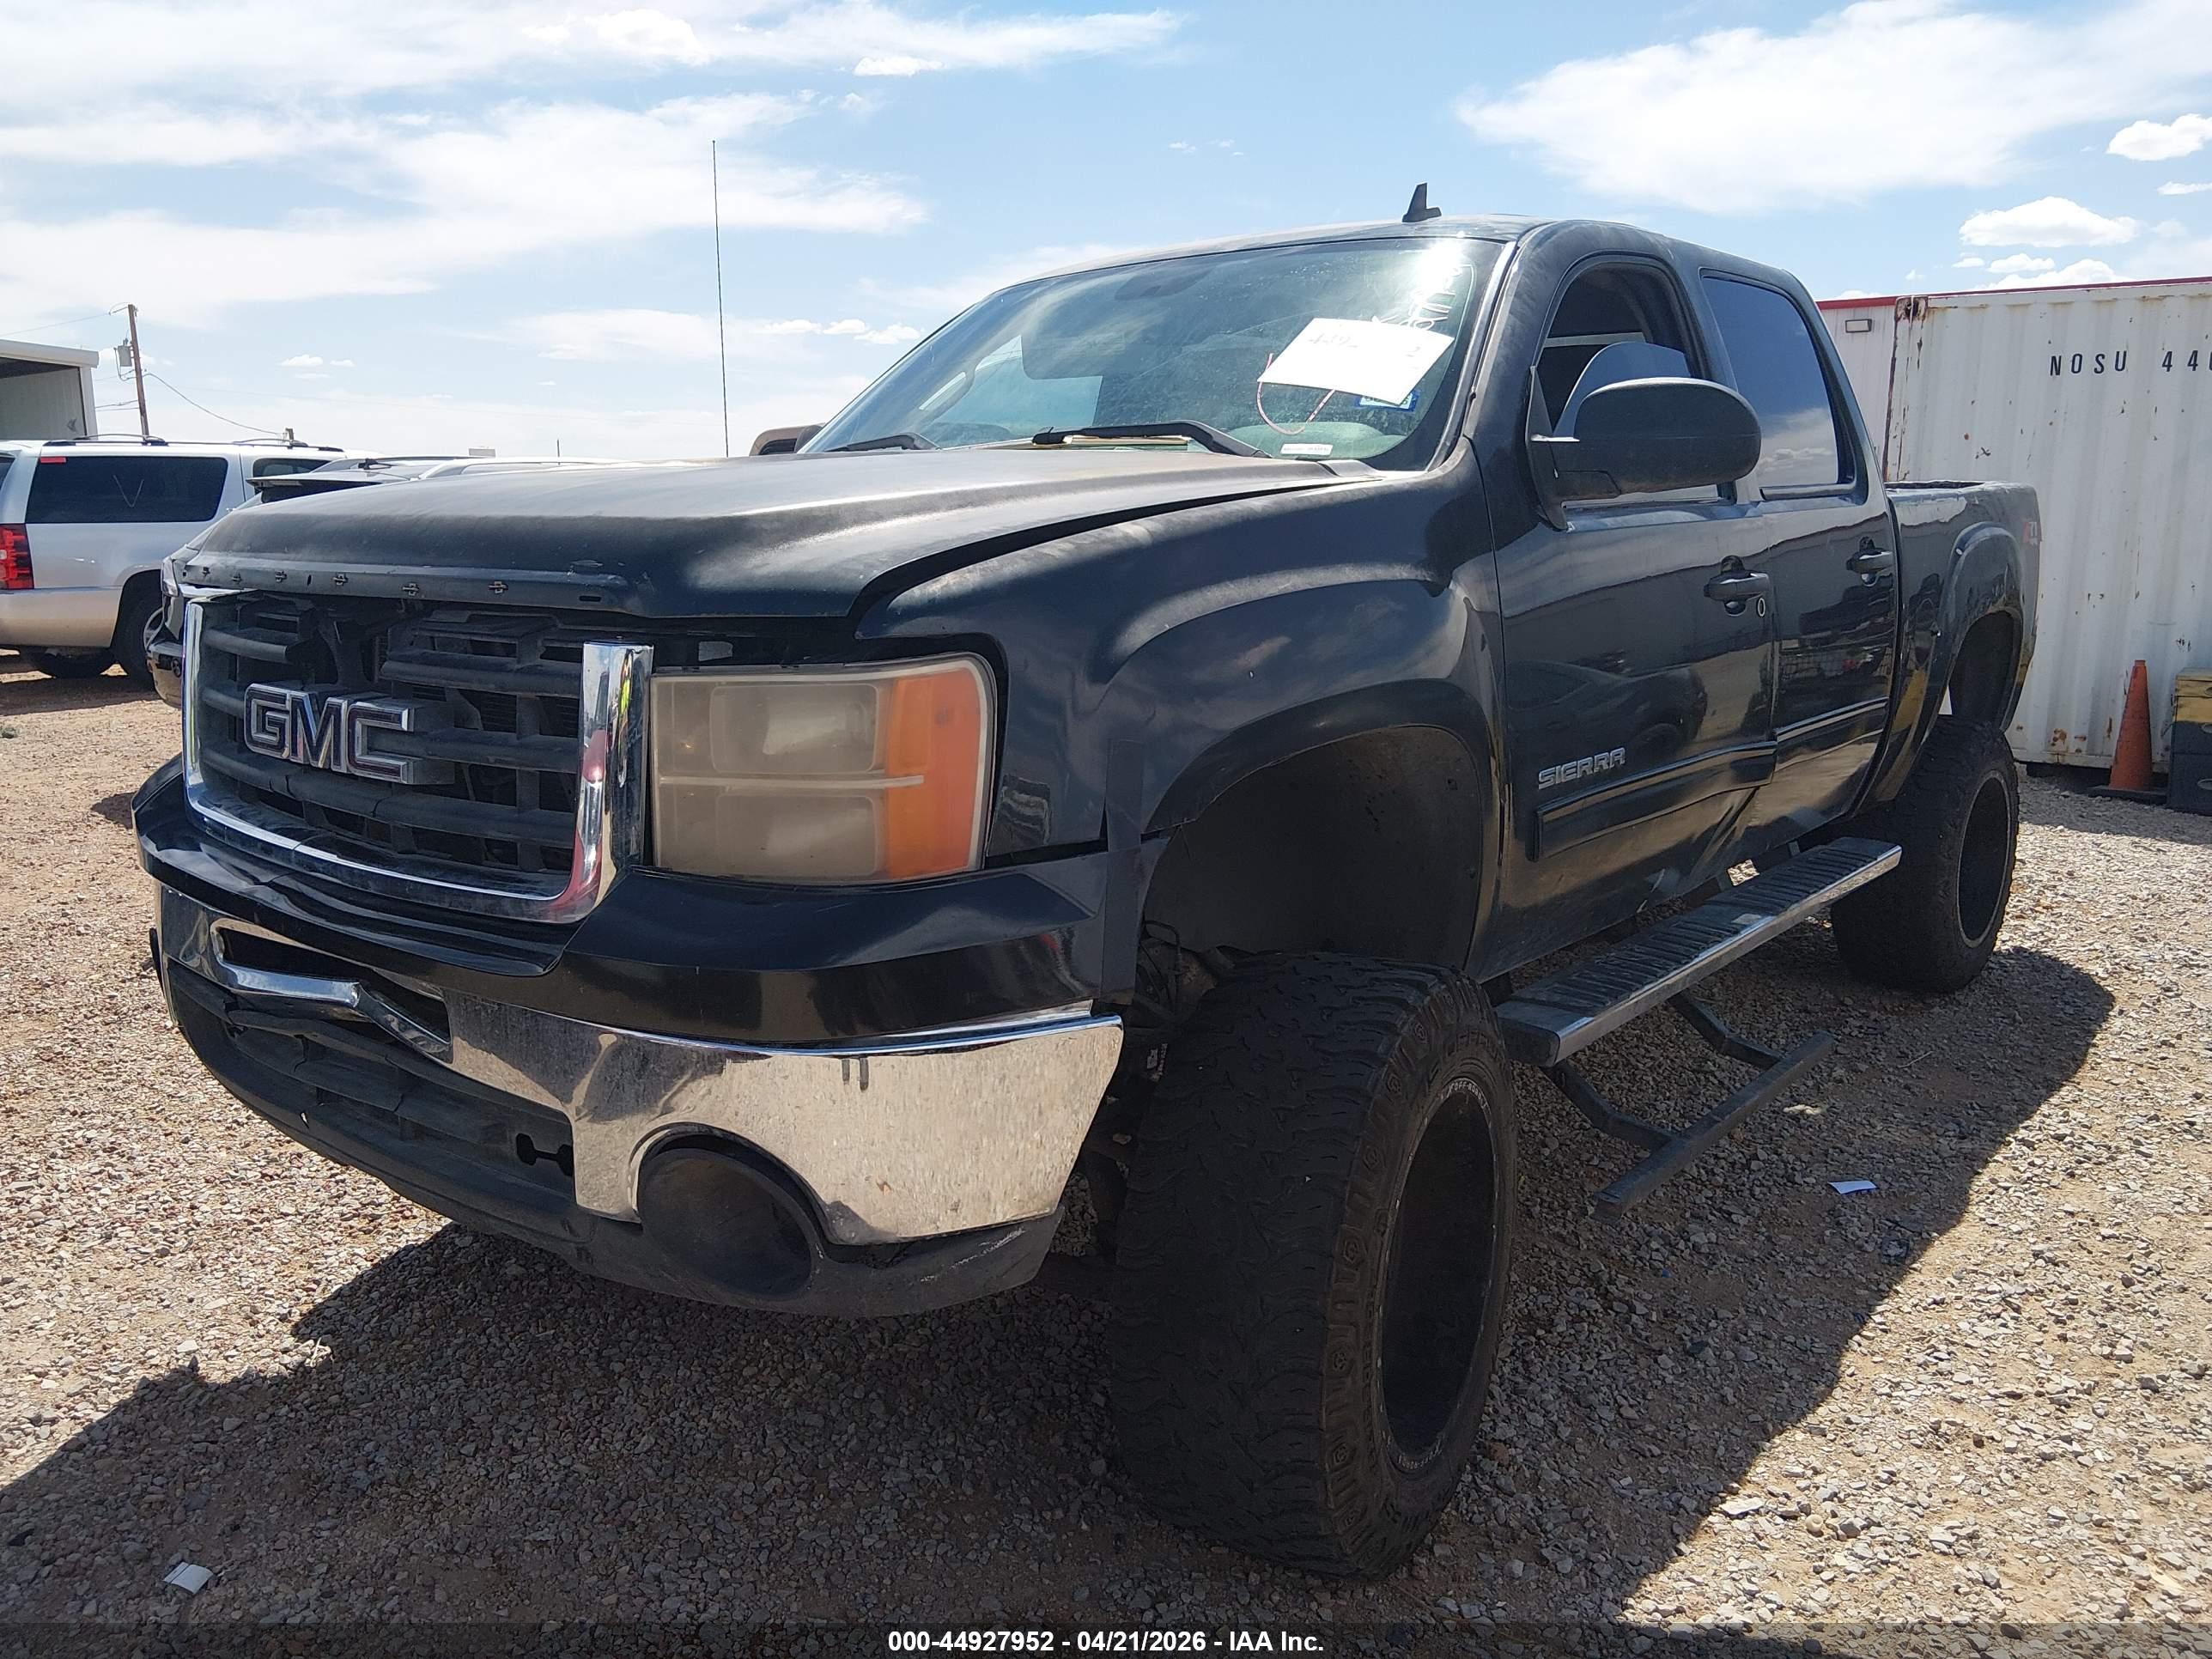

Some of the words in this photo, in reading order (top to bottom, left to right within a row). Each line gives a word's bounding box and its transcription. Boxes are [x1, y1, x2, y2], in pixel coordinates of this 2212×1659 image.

[2050, 349, 2128, 376] NOSU
[245, 683, 415, 785] GMC
[1538, 746, 1627, 790] SIERRA
